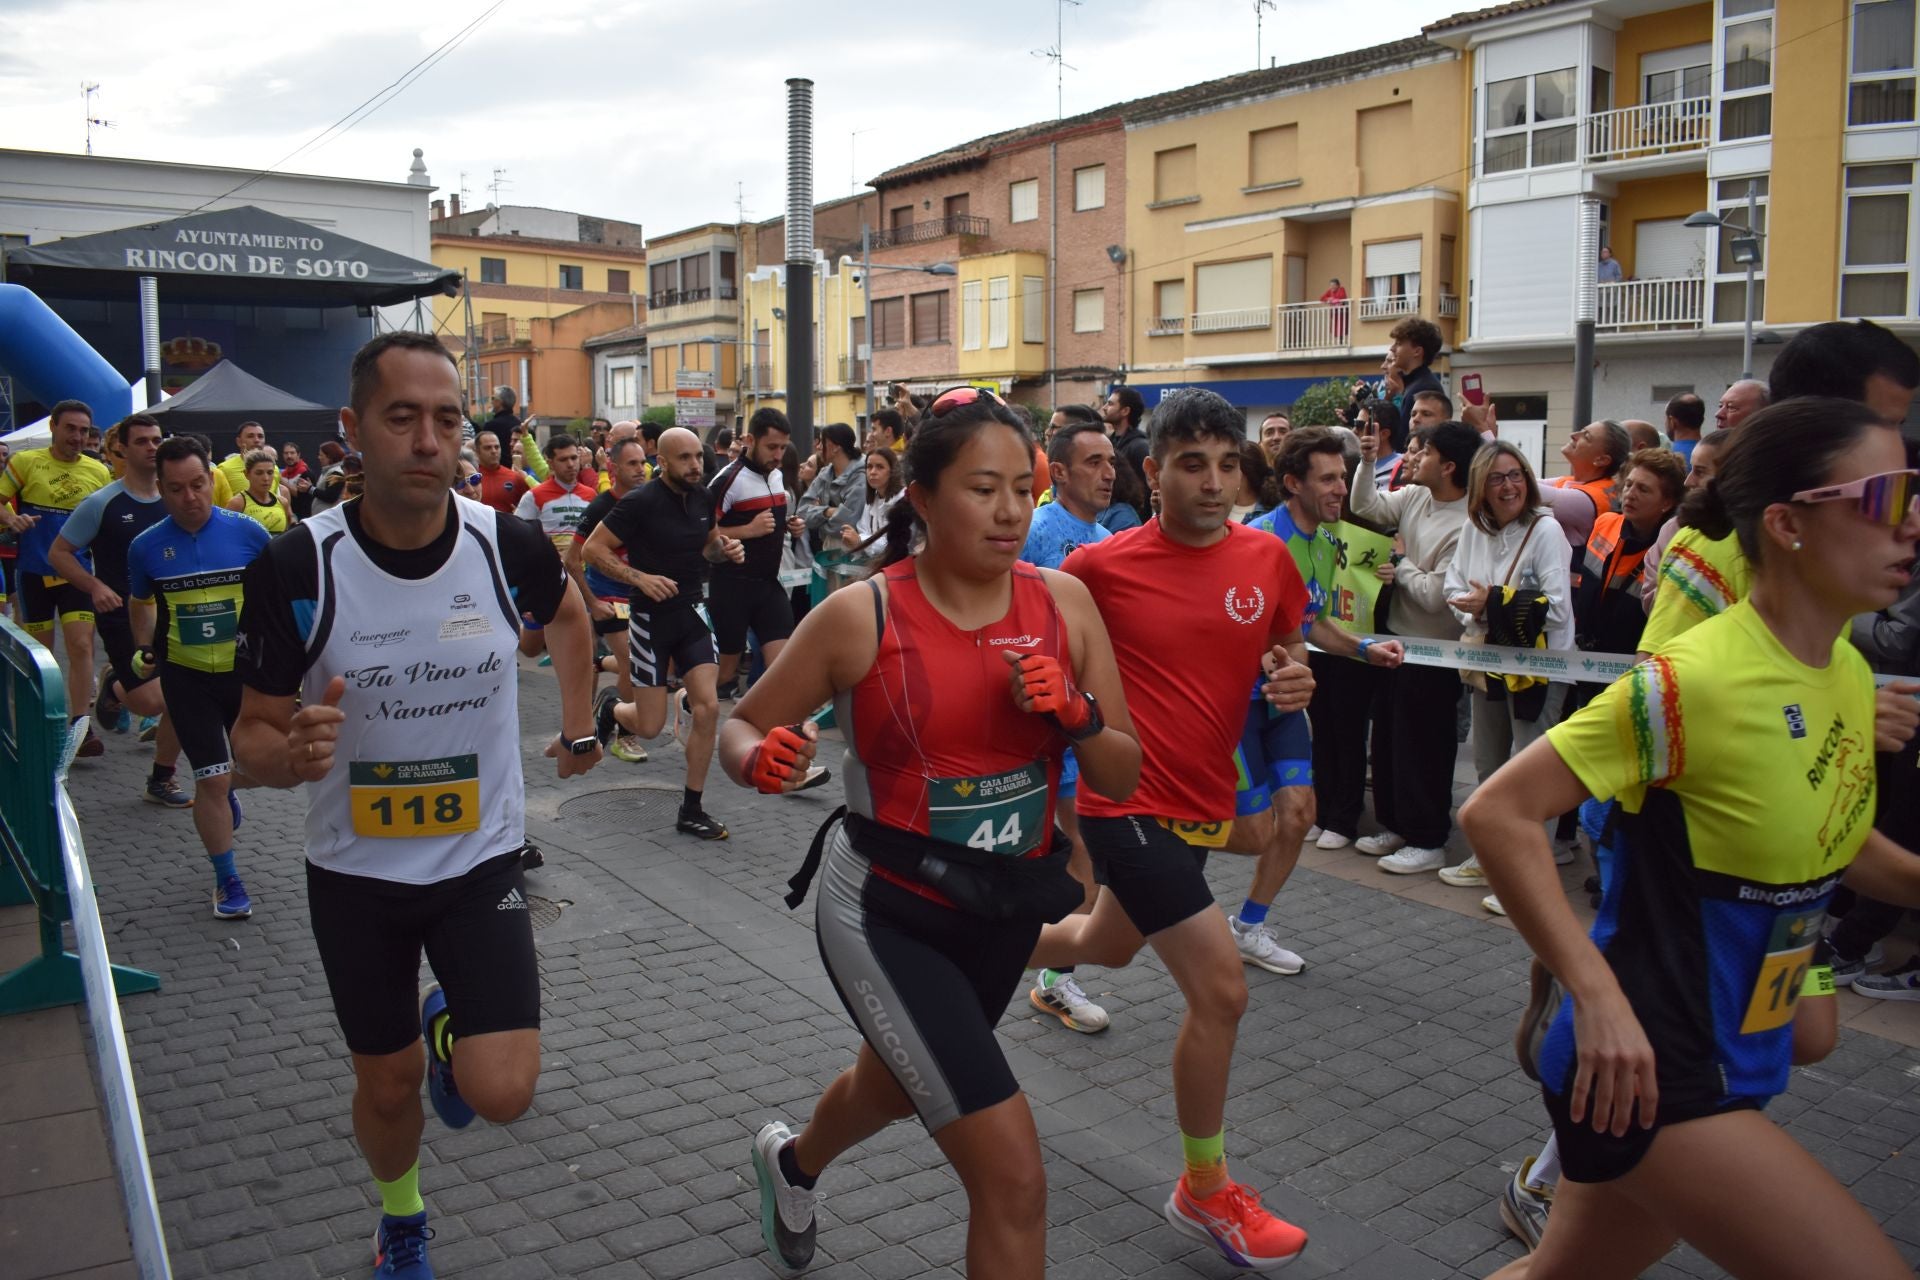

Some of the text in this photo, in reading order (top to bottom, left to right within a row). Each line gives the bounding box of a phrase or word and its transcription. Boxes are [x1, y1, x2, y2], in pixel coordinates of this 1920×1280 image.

[176, 229, 324, 250] AYUNTAMIENTO
[125, 248, 369, 279] RINCON DE SOTO
[183, 579, 194, 588] la
[197, 574, 241, 586] bascula
[1236, 597, 1257, 609] L.T.
[202, 621, 216, 638] 5
[350, 628, 411, 648] Emergente
[988, 634, 1031, 646] saucony
[404, 661, 471, 685] Vino
[477, 652, 502, 675] de
[1806, 712, 1846, 792] RINCON
[413, 768, 456, 778] NAVARRA
[421, 762, 452, 771] RURAL
[979, 771, 1029, 789] CAJA RURAL
[980, 788, 993, 797] DE
[995, 777, 1032, 794] NAVARRA
[371, 793, 463, 826] 118
[967, 812, 1023, 852] 44
[853, 979, 932, 1097] saucony
